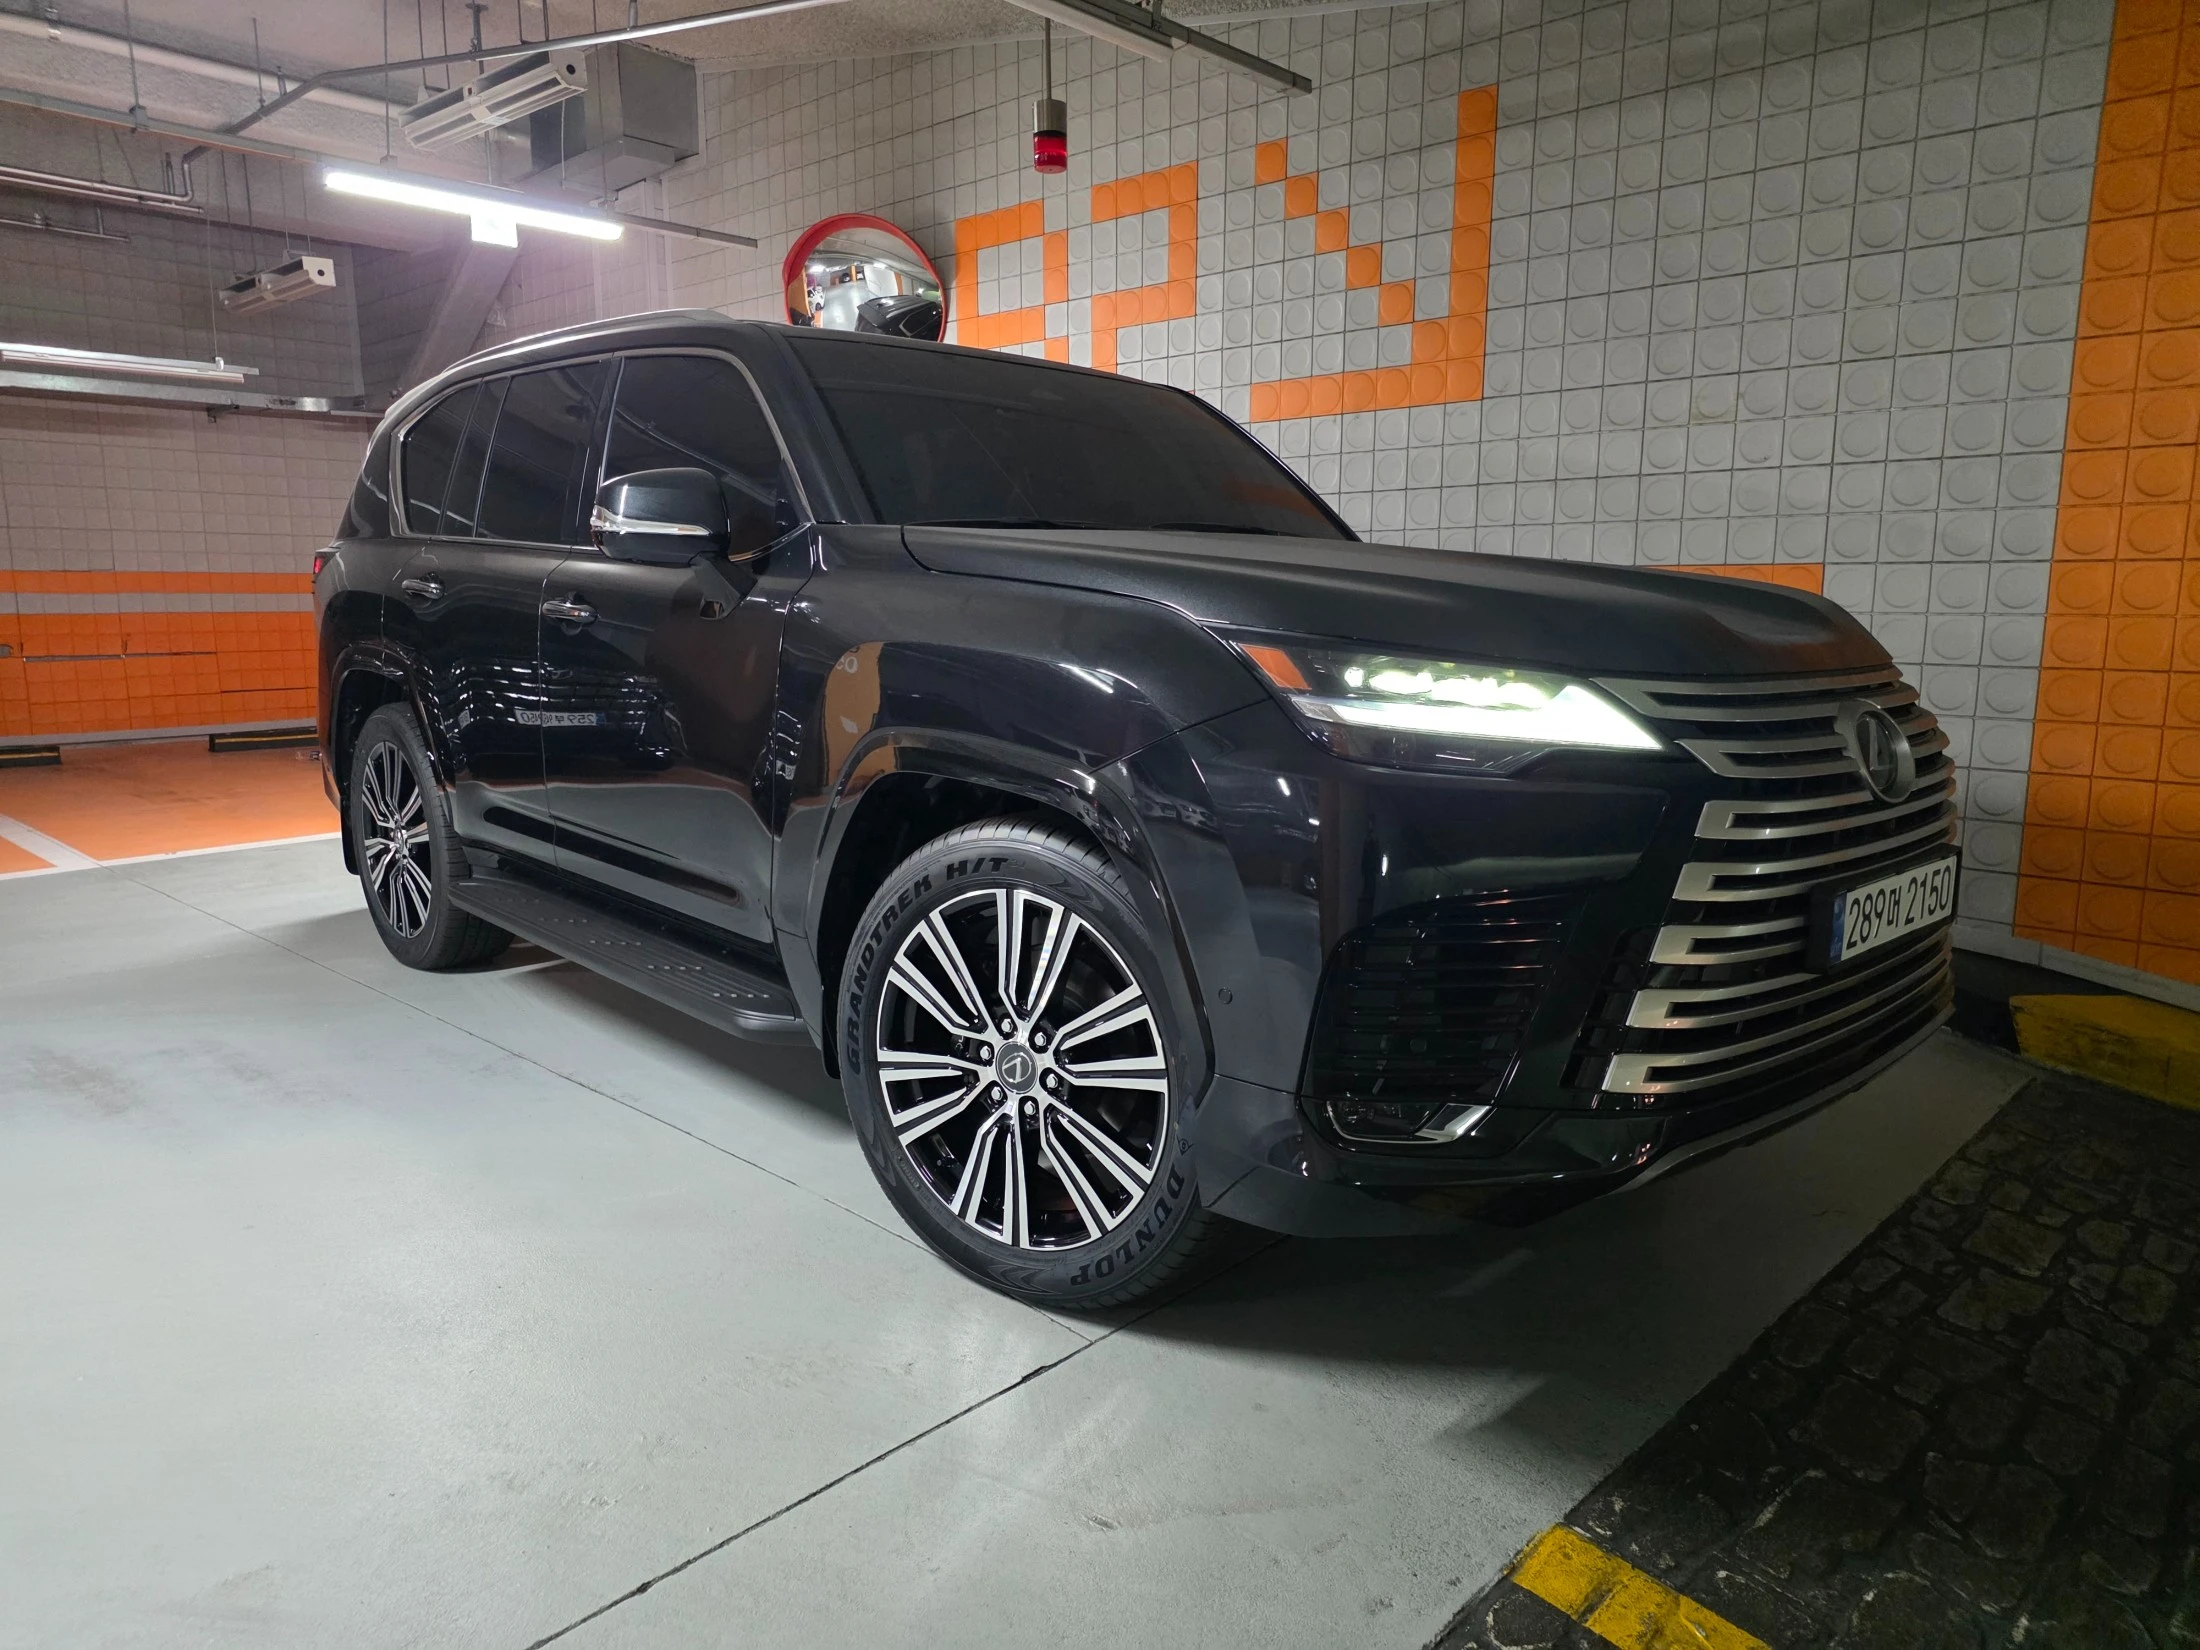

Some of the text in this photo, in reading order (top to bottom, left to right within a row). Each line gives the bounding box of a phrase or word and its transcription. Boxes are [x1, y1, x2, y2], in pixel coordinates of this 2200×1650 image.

[847, 874, 932, 1075] GRANDTREK
[946, 857, 1009, 881] H/T
[1846, 865, 1952, 951] 289머 2150
[1070, 1163, 1185, 1286] DUNLOP
